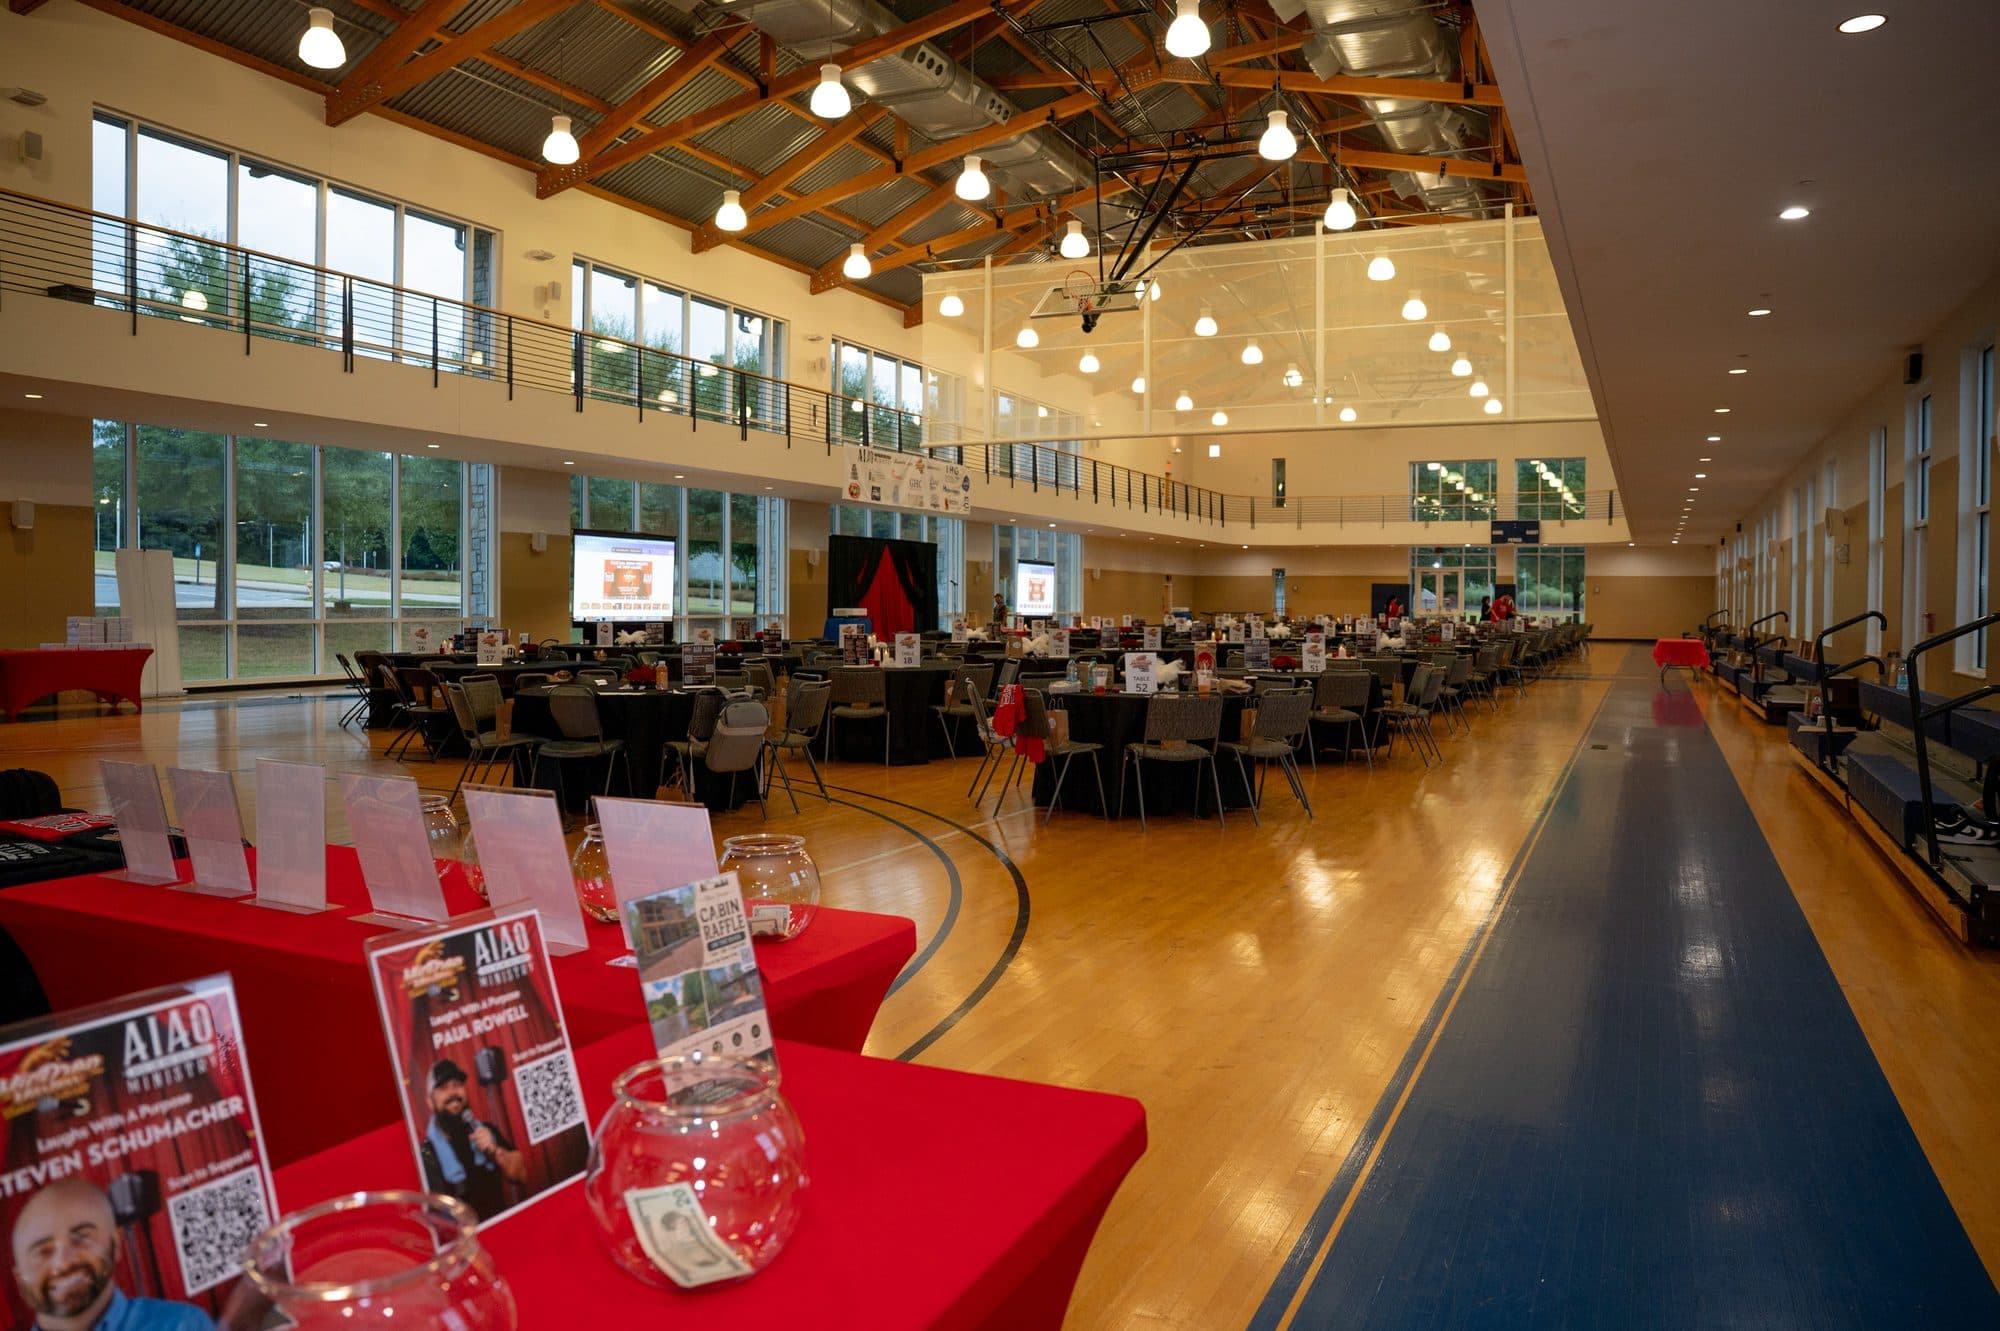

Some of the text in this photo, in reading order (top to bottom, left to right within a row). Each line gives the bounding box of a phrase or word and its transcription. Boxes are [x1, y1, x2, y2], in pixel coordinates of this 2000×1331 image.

[1135, 683, 1148, 692] 52
[700, 899, 741, 922] CABIN
[703, 914, 746, 940] RAFFLE
[475, 922, 530, 967] AIAO
[124, 1003, 213, 1065] AIAO
[432, 1004, 529, 1050] PAUL ROWELL
[126, 1056, 217, 1093] MINISTRY
[0, 1095, 246, 1198] TEVEN SCHUMACHER
